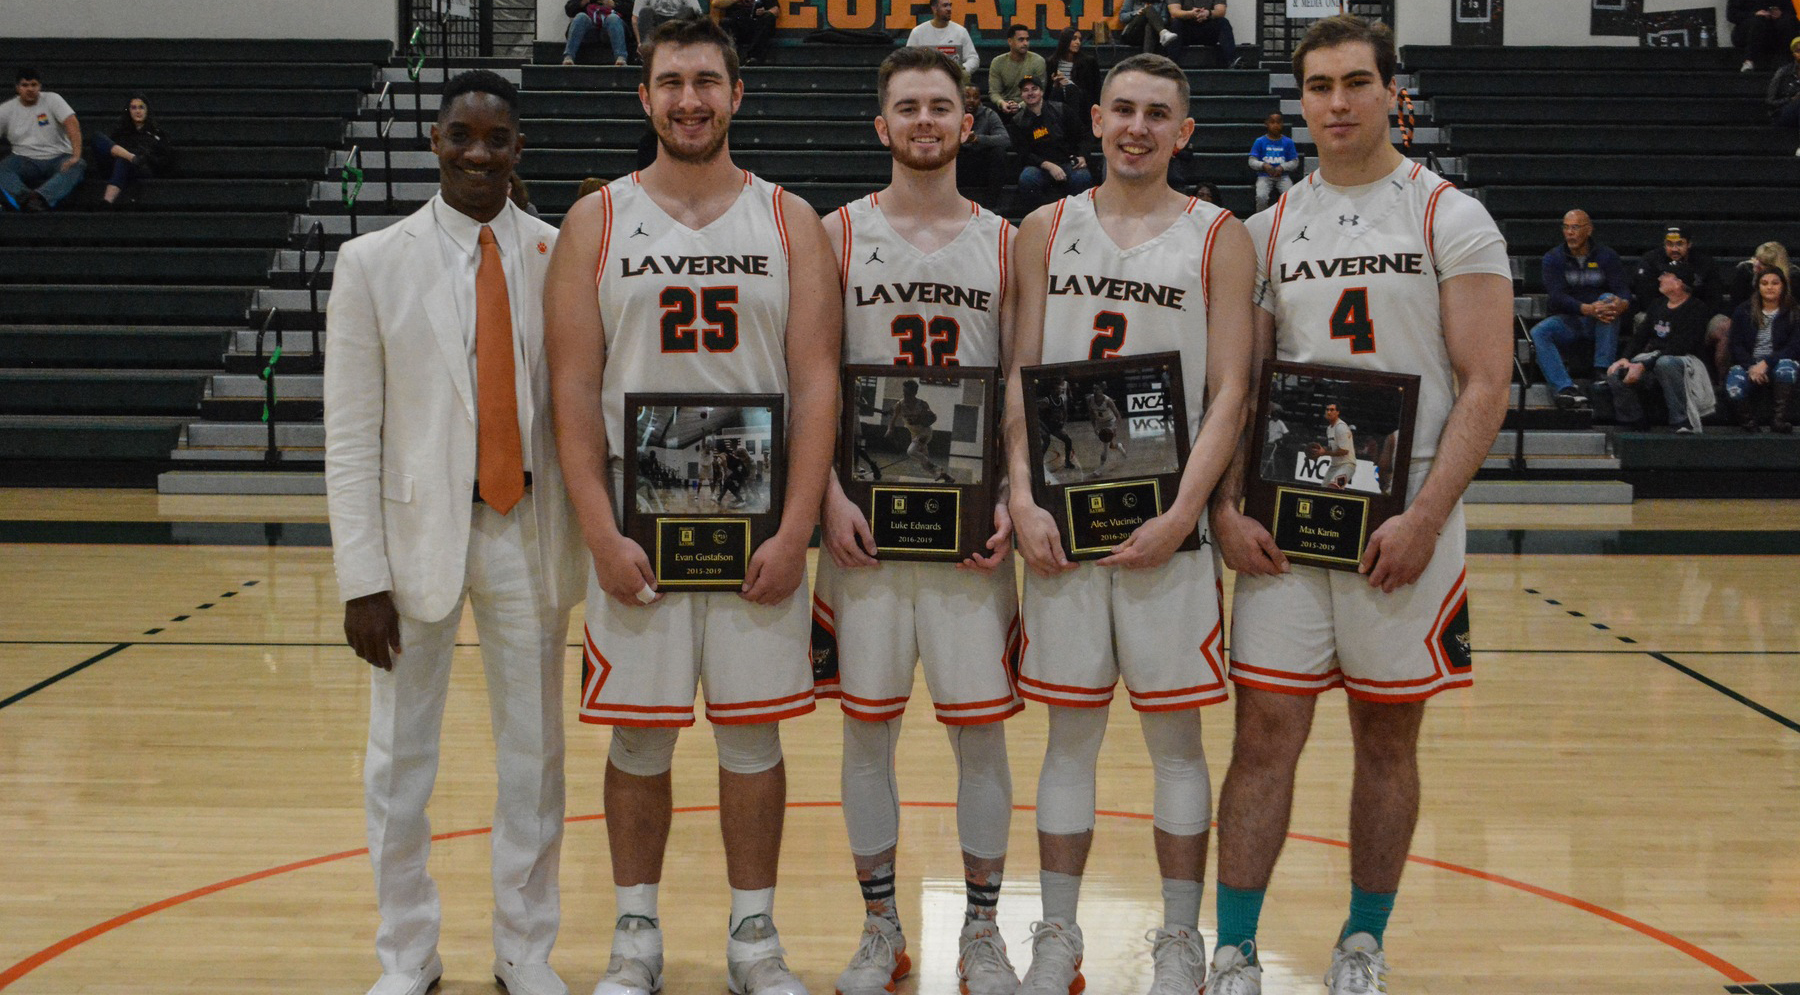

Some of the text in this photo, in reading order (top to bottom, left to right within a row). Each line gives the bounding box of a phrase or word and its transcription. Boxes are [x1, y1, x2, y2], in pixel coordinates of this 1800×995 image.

[659, 285, 739, 353] 25
[1329, 286, 1376, 355] 4
[890, 314, 960, 367] 32
[1088, 310, 1128, 360] 2
[1131, 395, 1165, 410] NCA
[890, 521, 942, 531] Luke Edwards
[1090, 516, 1143, 528] Alec Vucinich
[1100, 532, 1131, 541] 2016-201
[1299, 525, 1340, 537] Max Karim
[1300, 541, 1335, 550] 2015-2019
[675, 553, 734, 561] Evan Gustafson
